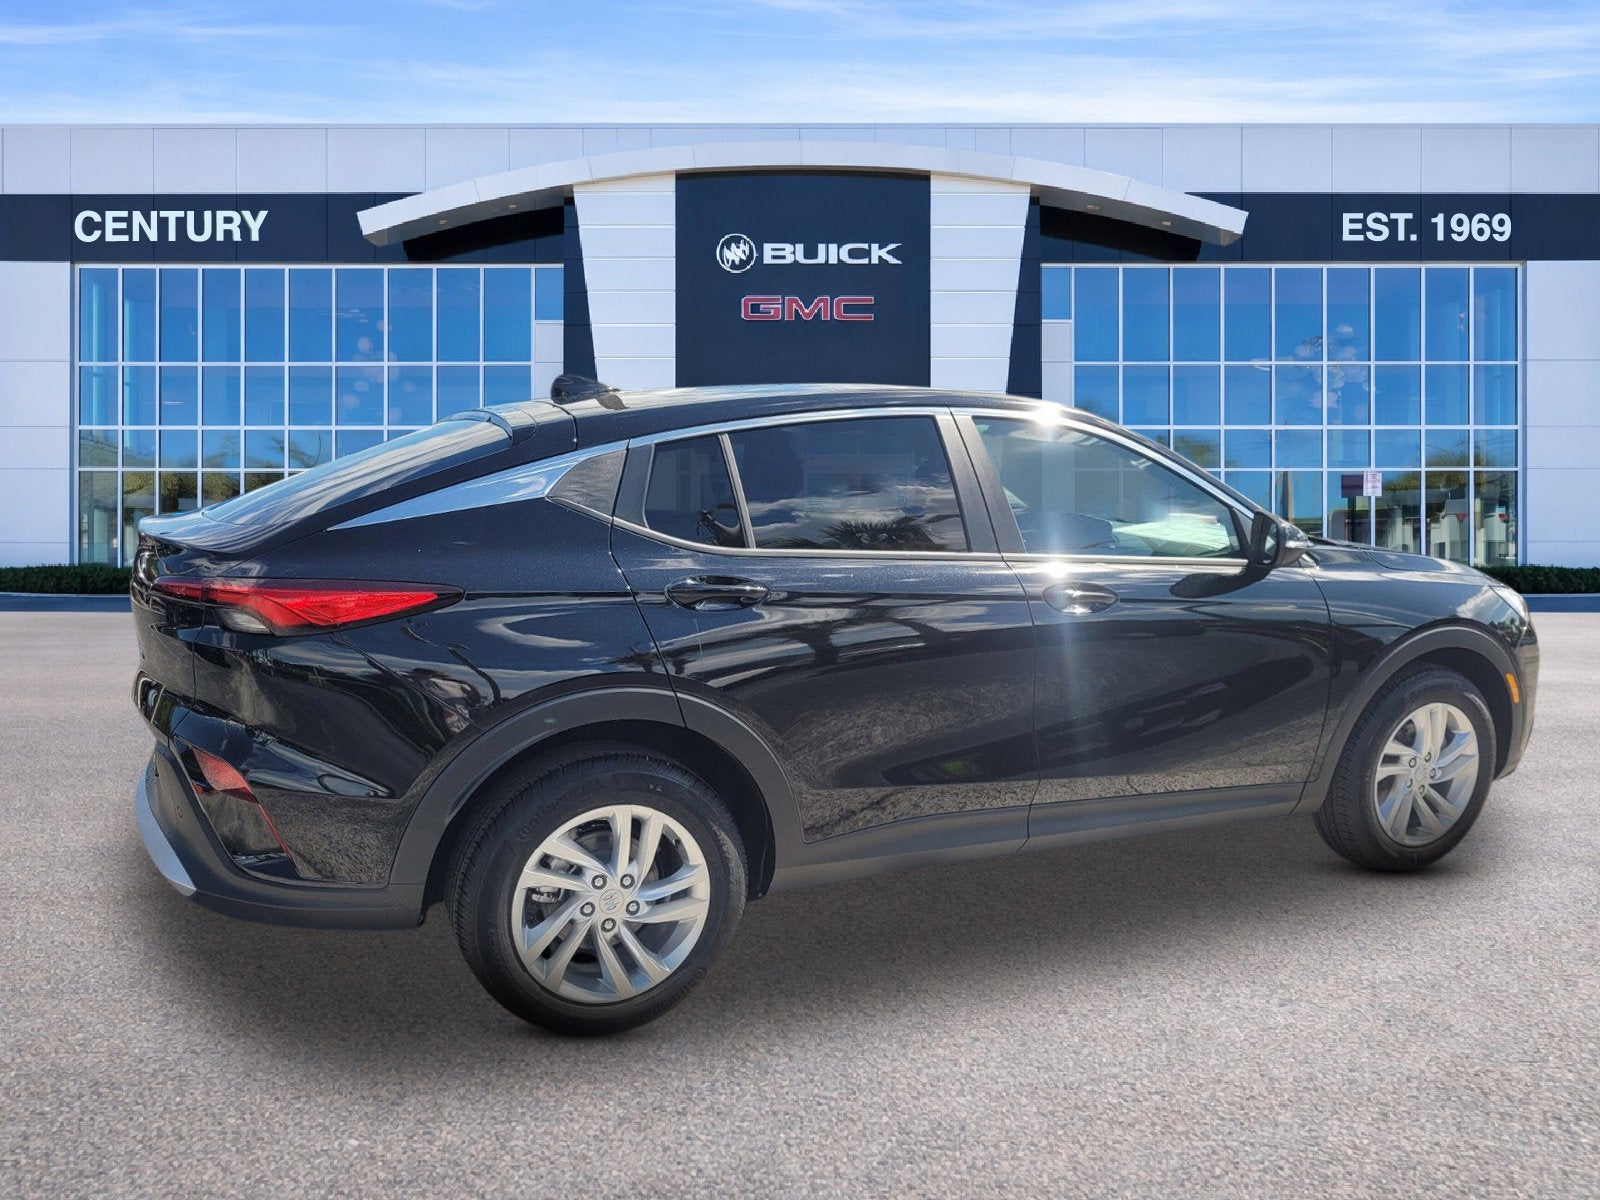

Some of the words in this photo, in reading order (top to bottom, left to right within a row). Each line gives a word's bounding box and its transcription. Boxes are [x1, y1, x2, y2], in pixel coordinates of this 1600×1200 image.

[74, 210, 268, 243] CENTURY
[1342, 212, 1418, 242] EST.
[1431, 212, 1512, 242] 1969
[763, 242, 903, 265] BUICK
[741, 294, 875, 321] GMC
